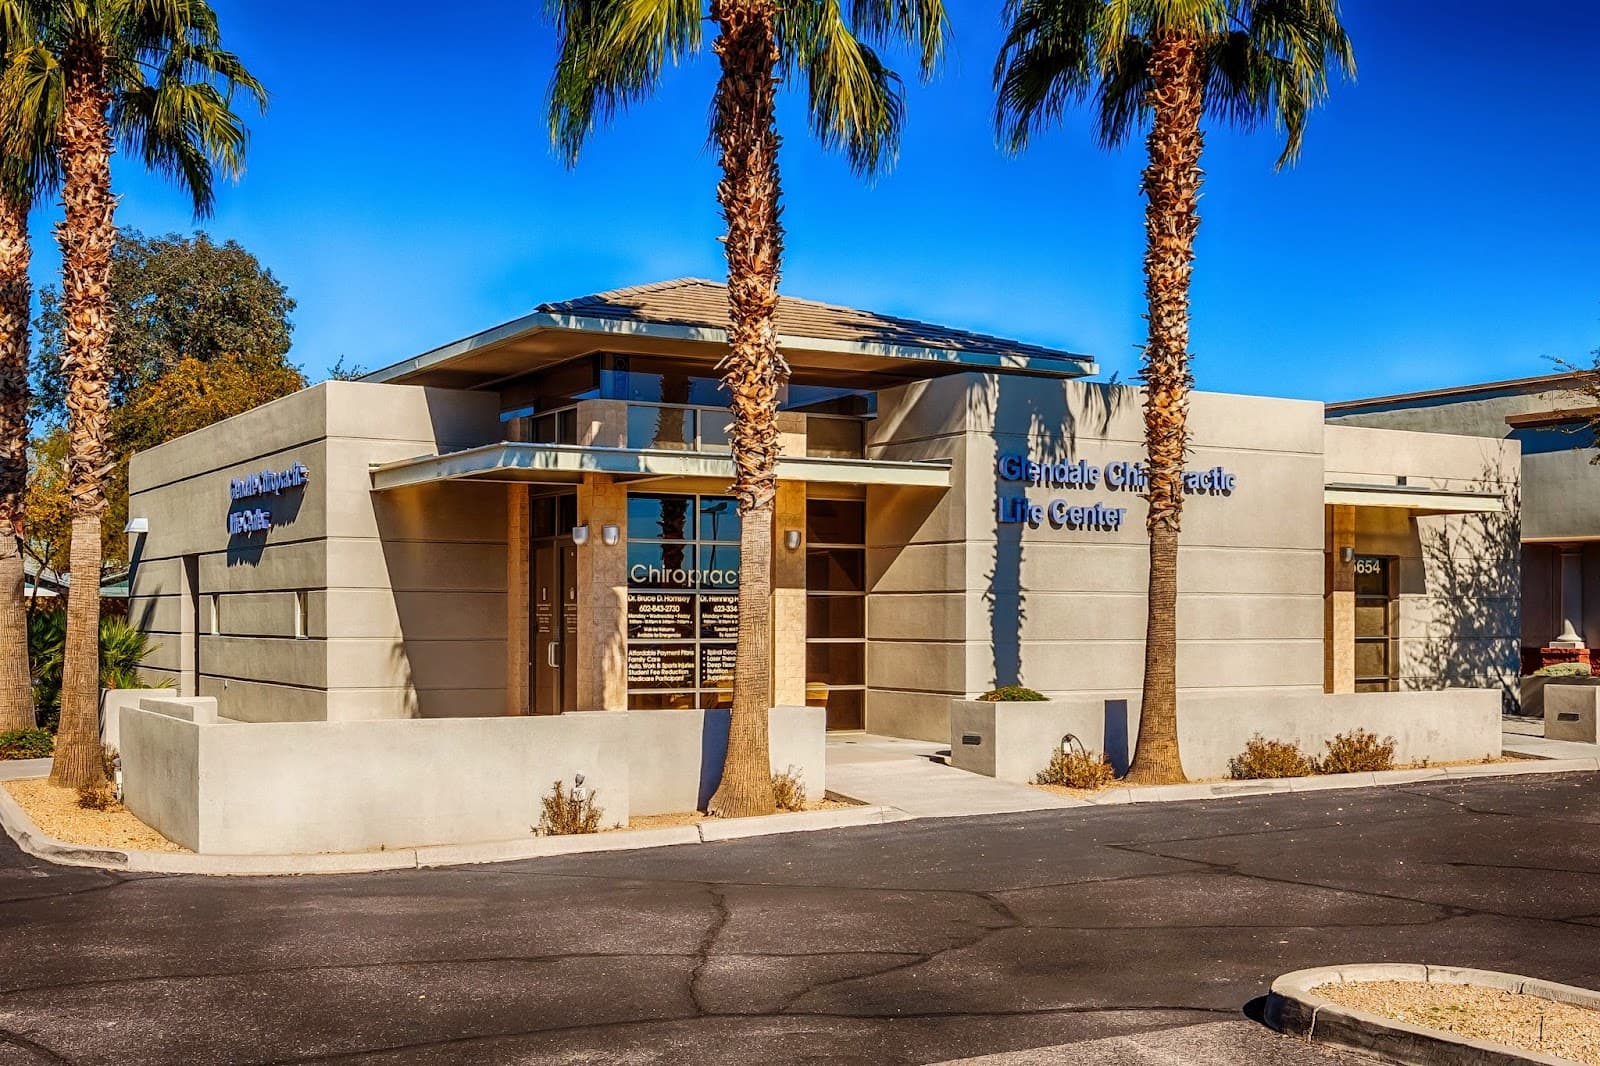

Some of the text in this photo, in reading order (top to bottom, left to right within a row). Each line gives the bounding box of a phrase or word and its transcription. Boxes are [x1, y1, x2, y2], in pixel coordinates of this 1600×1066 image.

[999, 456, 1236, 490] Glendale Chiractic
[1000, 496, 1127, 526] Life Center
[630, 564, 740, 588] Chiroprac
[1353, 559, 1381, 574] 654
